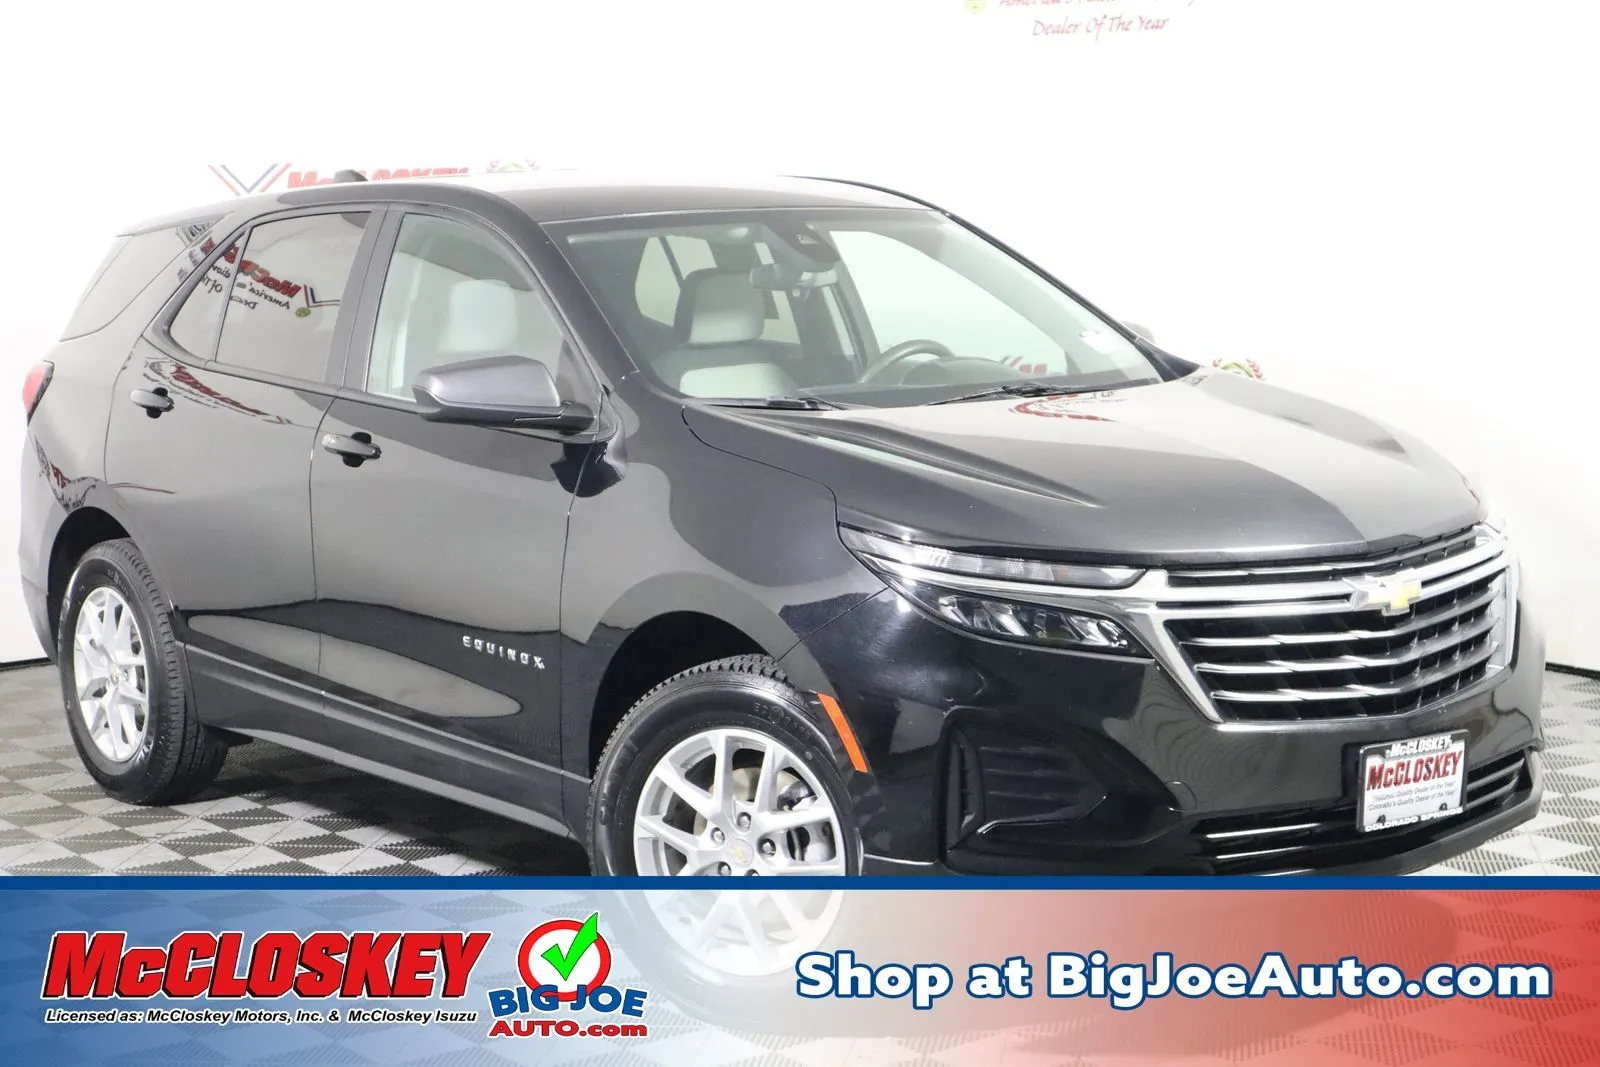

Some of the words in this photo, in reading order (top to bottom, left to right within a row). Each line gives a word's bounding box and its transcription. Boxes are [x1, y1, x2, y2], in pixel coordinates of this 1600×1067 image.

[1032, 16, 1081, 36] Dealer
[1108, 14, 1134, 33] The
[1138, 15, 1170, 31] Year
[462, 635, 545, 670] EQUINOX
[1390, 735, 1452, 758] McCLOSKEY
[1366, 751, 1463, 791] McCLOSKEY
[1365, 816, 1419, 832] COLORADO
